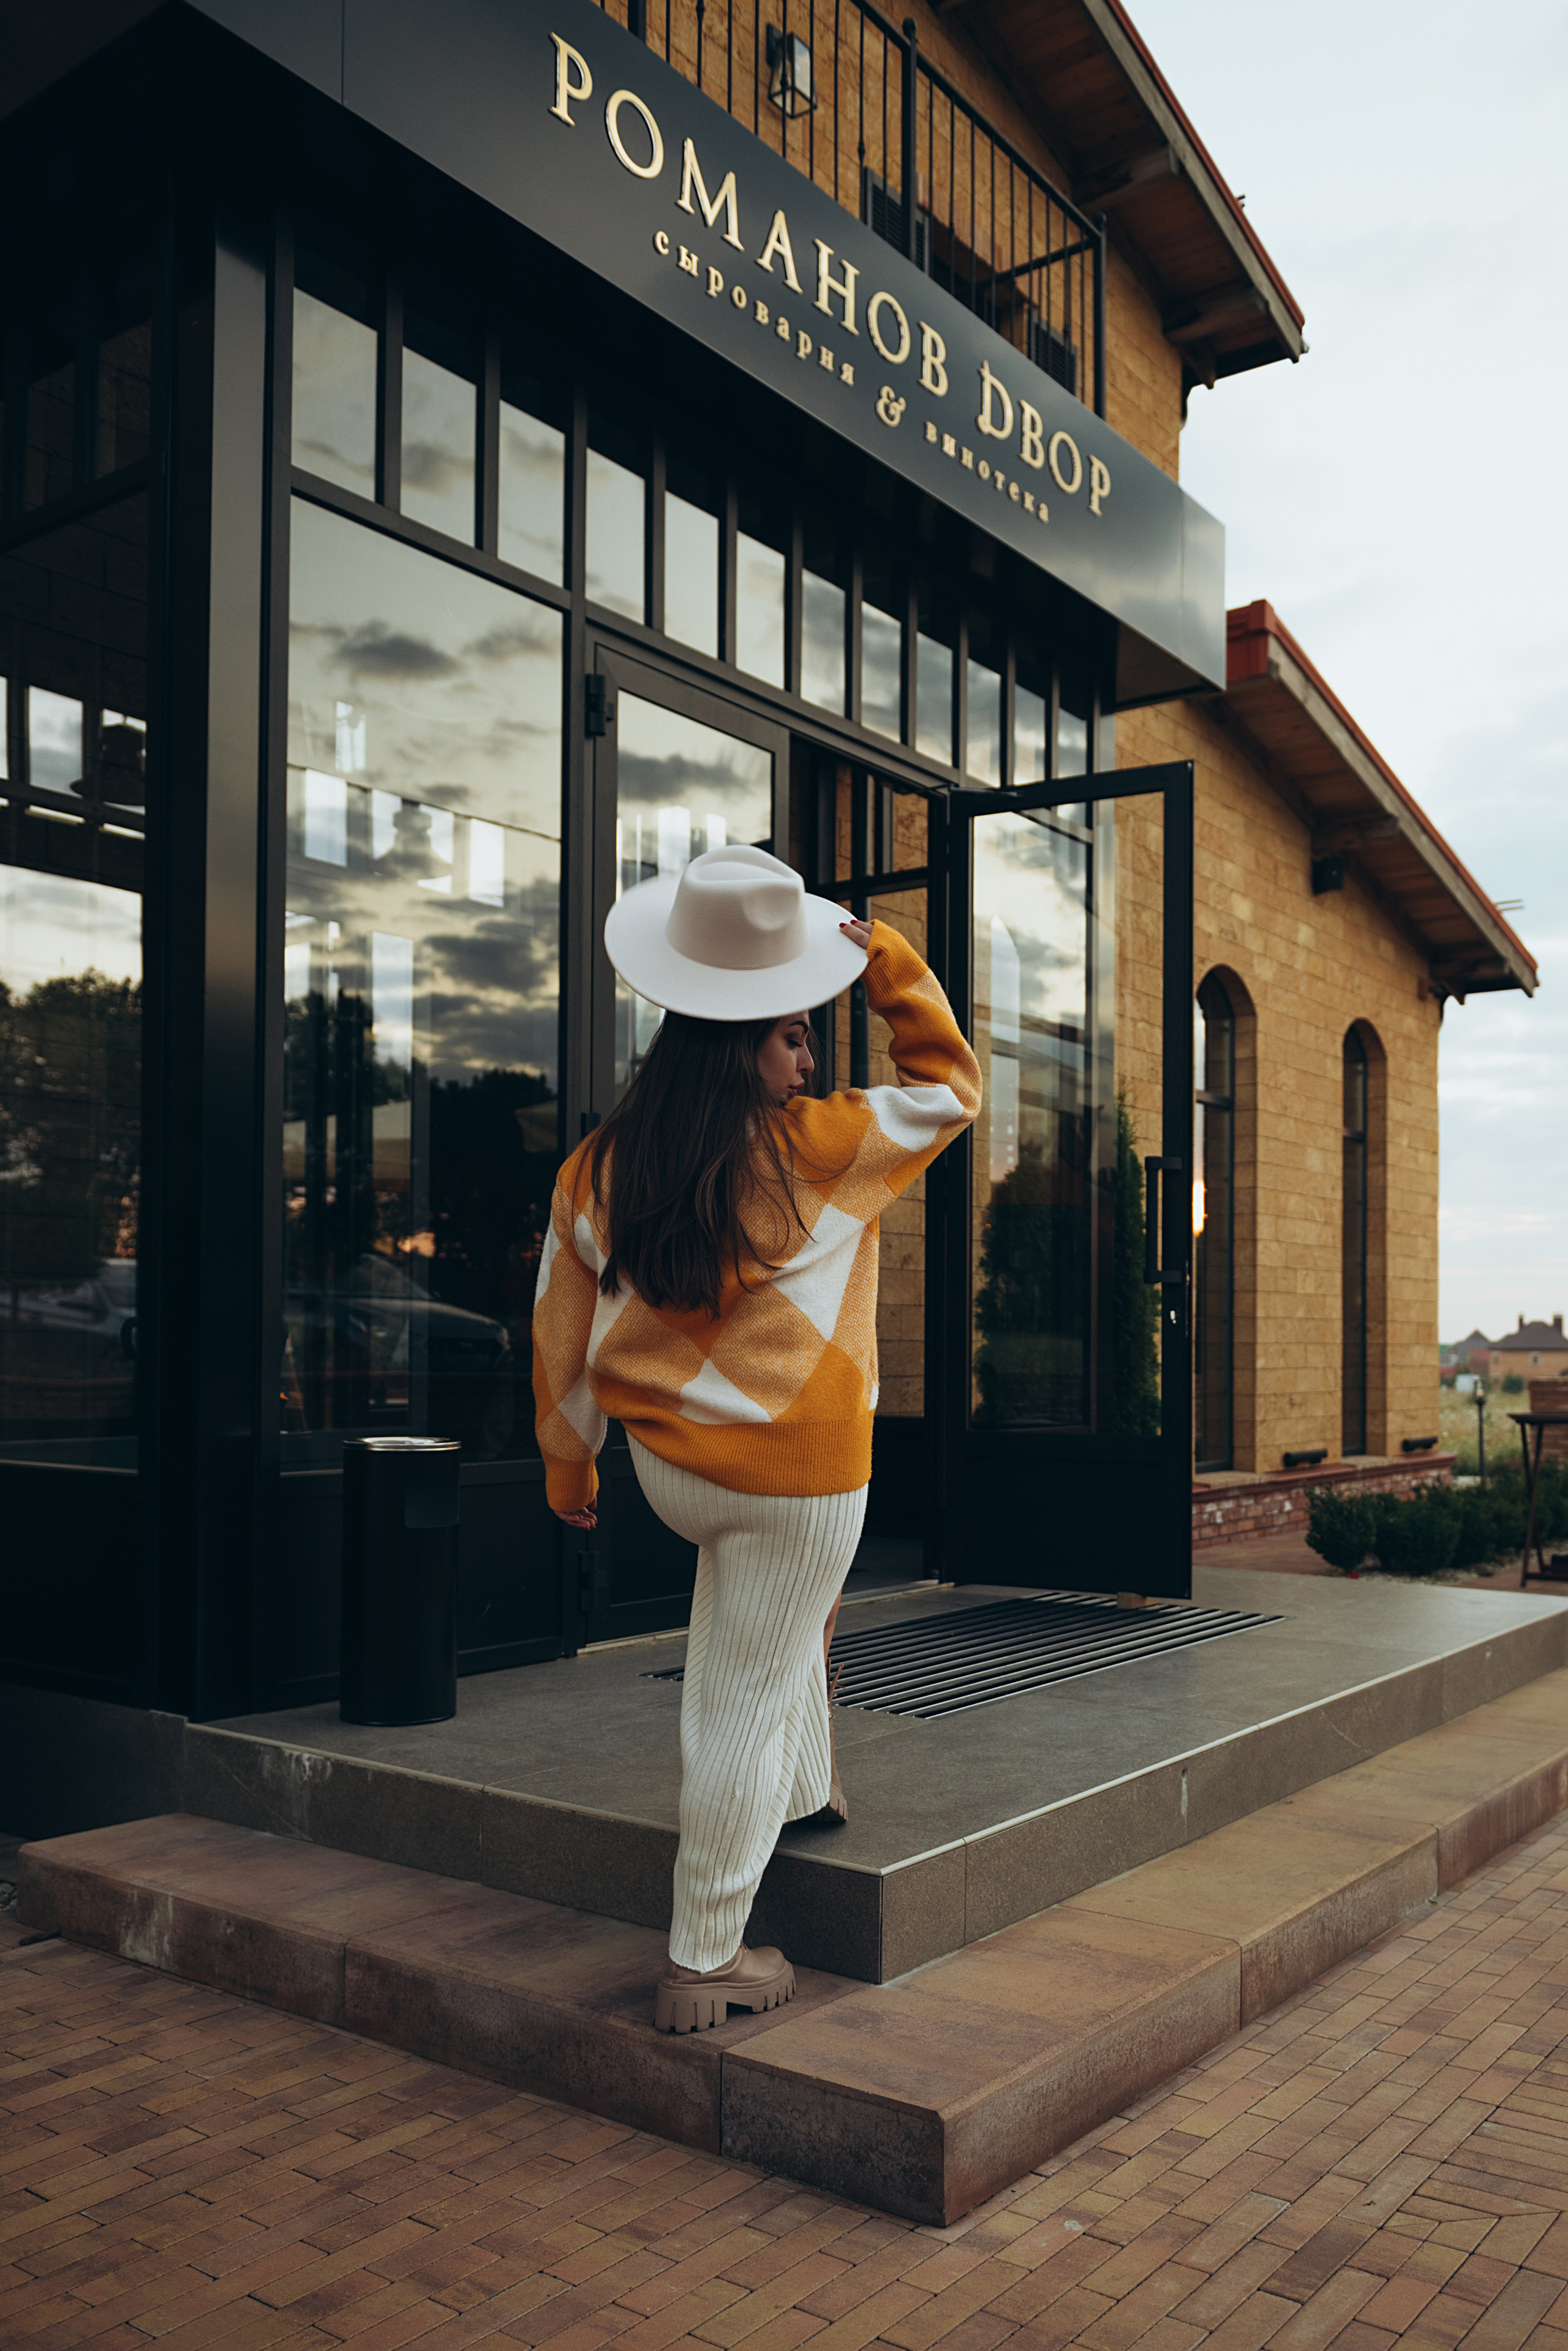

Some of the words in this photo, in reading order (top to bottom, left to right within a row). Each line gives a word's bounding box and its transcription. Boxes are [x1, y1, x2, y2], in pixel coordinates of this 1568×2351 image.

[549, 32, 949, 397] РОМАНОВ
[654, 230, 855, 387] сыроварня
[876, 385, 907, 428] &
[925, 421, 1050, 524] винотека
